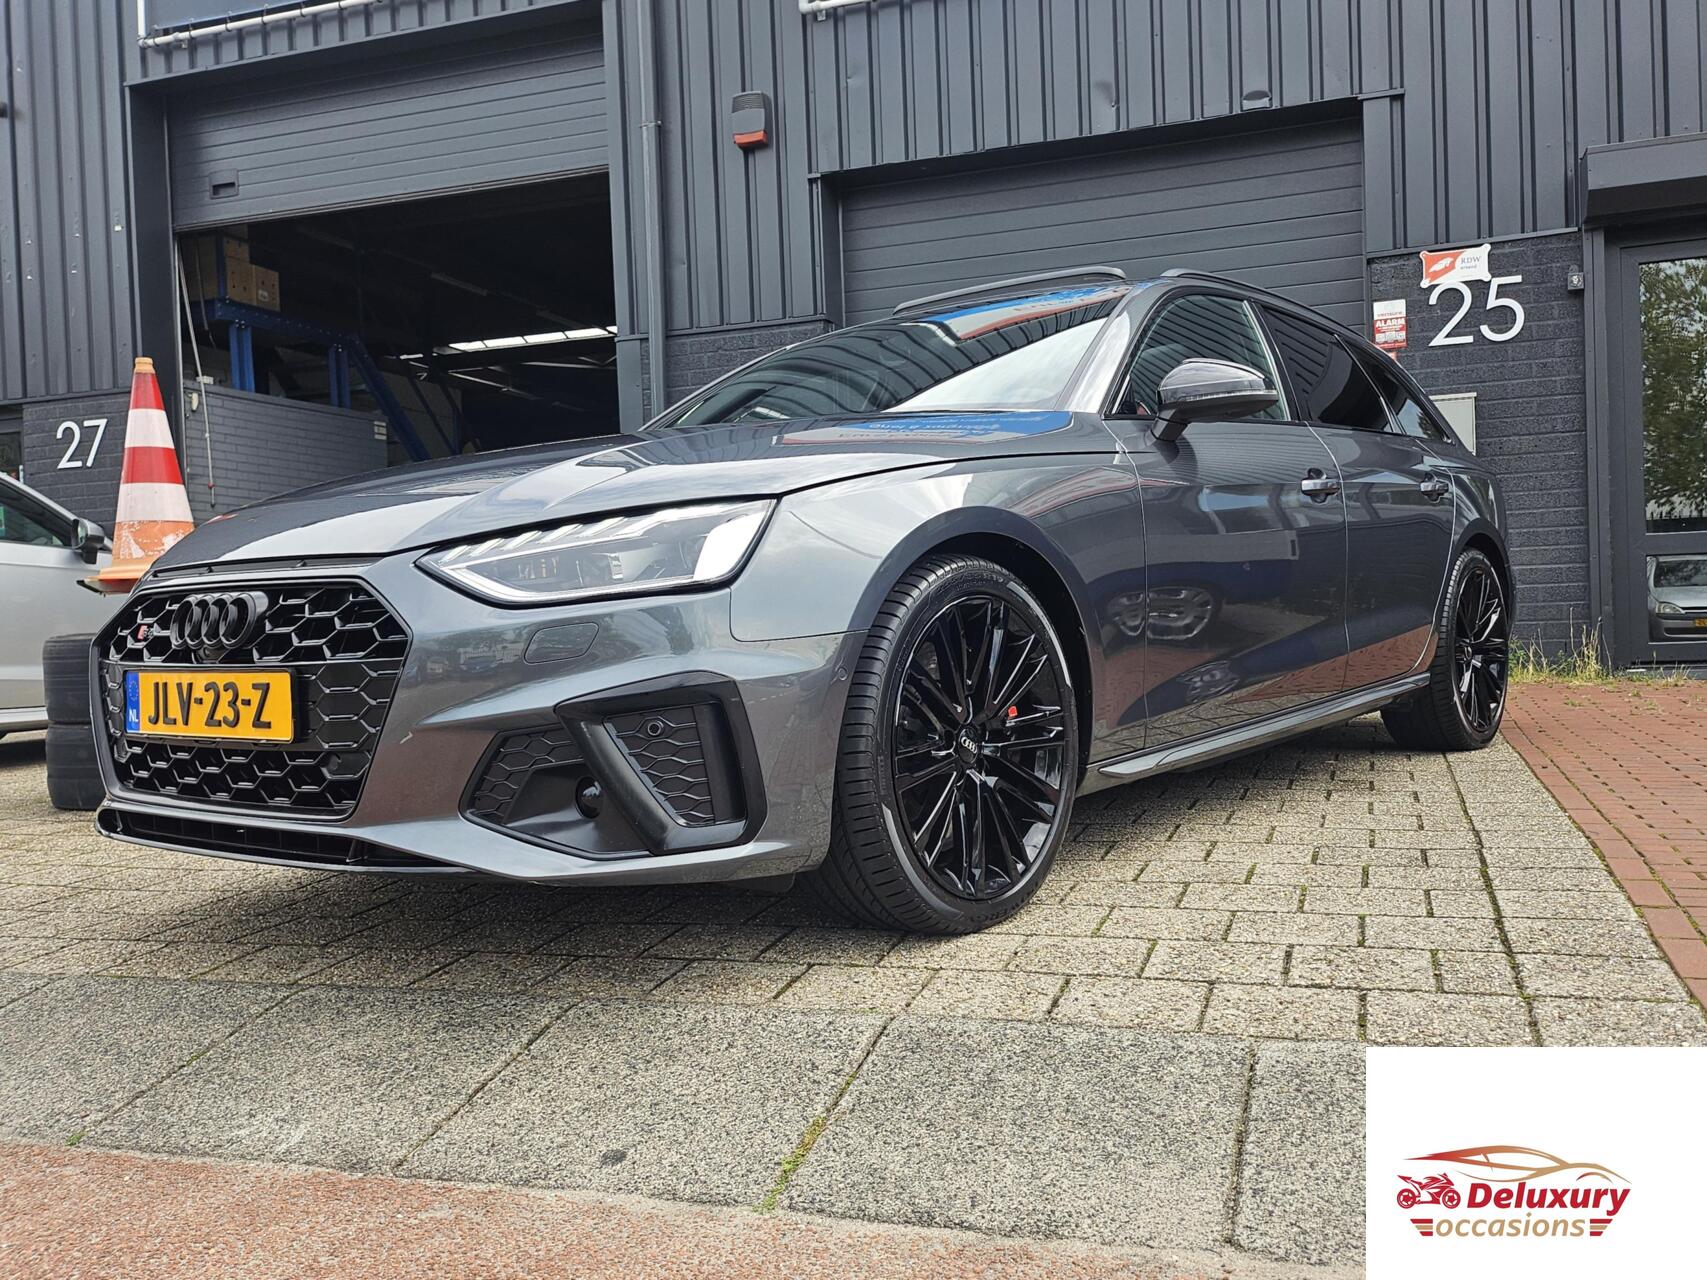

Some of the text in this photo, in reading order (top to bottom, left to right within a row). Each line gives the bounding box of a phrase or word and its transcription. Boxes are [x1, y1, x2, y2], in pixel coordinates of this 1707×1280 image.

[1461, 256, 1482, 264] RDW
[1376, 318, 1406, 328] ALARM
[1428, 275, 1525, 346] 25
[56, 418, 108, 469] 27
[128, 708, 139, 722] NL
[148, 681, 272, 729] JLV-23-Z
